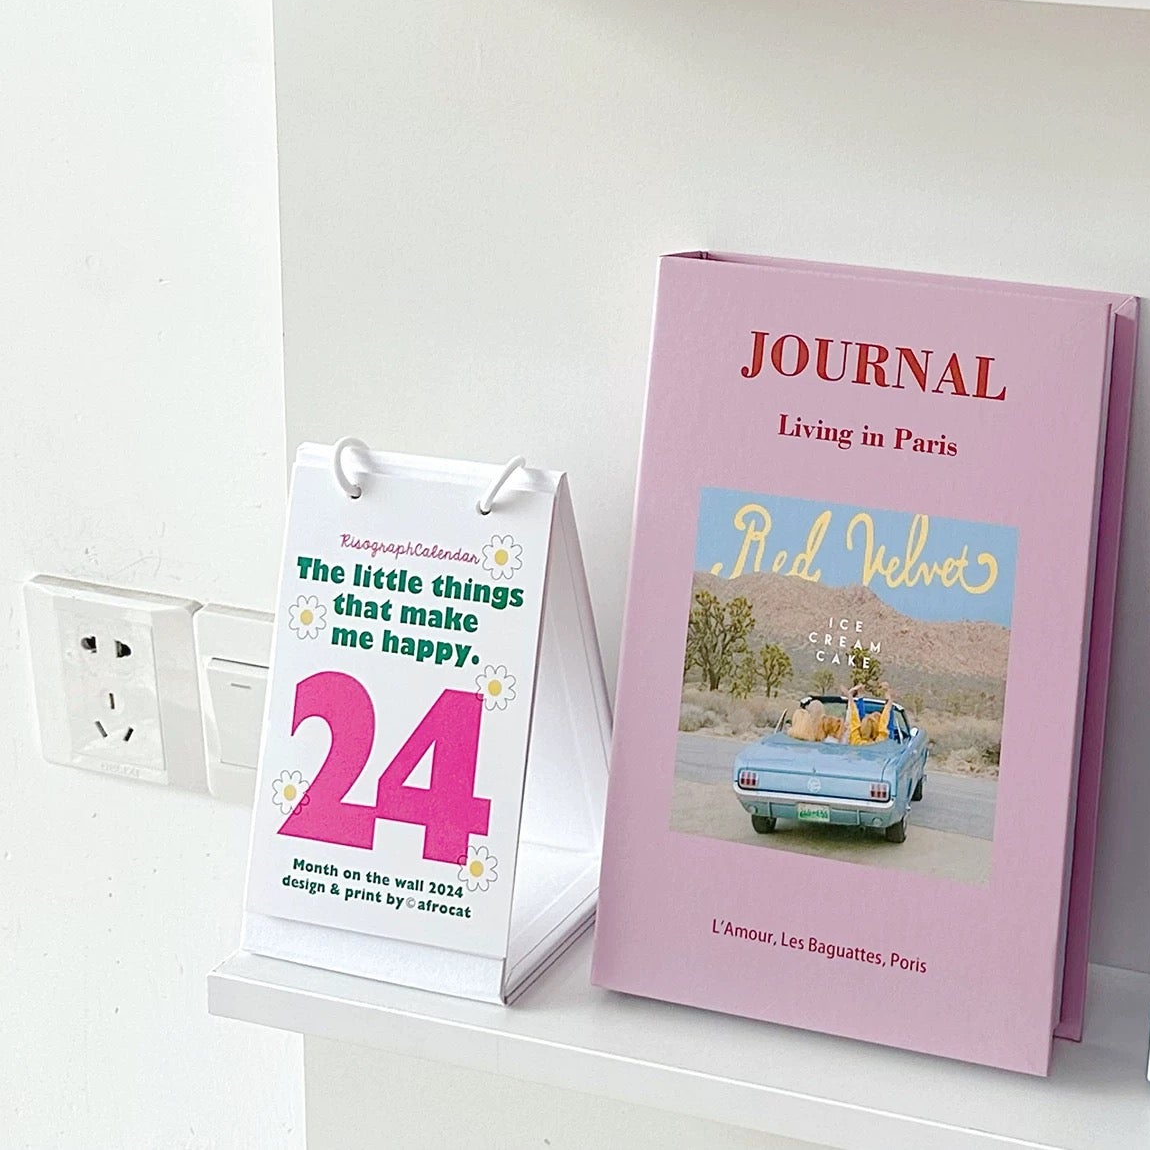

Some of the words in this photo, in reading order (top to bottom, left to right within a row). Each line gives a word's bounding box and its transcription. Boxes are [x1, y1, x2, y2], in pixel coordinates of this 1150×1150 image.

[741, 330, 1007, 401] JOURNAL
[778, 414, 854, 449] Living
[861, 425, 884, 447] in
[893, 427, 958, 456] Paris
[710, 504, 832, 582] Red
[846, 513, 998, 594] Velvet
[297, 556, 344, 583] The
[354, 564, 423, 594] little
[432, 574, 524, 610] things
[333, 593, 391, 621] that
[401, 604, 478, 633] make
[829, 618, 863, 632] ICE
[331, 626, 374, 649] me
[382, 630, 480, 667] happy.
[809, 632, 881, 653] CREAM
[816, 651, 870, 668] CAKE
[278, 671, 491, 865] 24
[282, 875, 325, 894] design
[330, 883, 339, 895] &
[345, 885, 382, 903] print
[293, 858, 338, 878] Month
[344, 869, 361, 880] on
[366, 872, 390, 886] the
[395, 876, 424, 892] wall
[430, 882, 463, 898] 2024
[712, 919, 777, 946] L'Amour,
[781, 932, 804, 950] Les
[808, 937, 887, 967] Baguattes,
[890, 953, 927, 973] Poris
